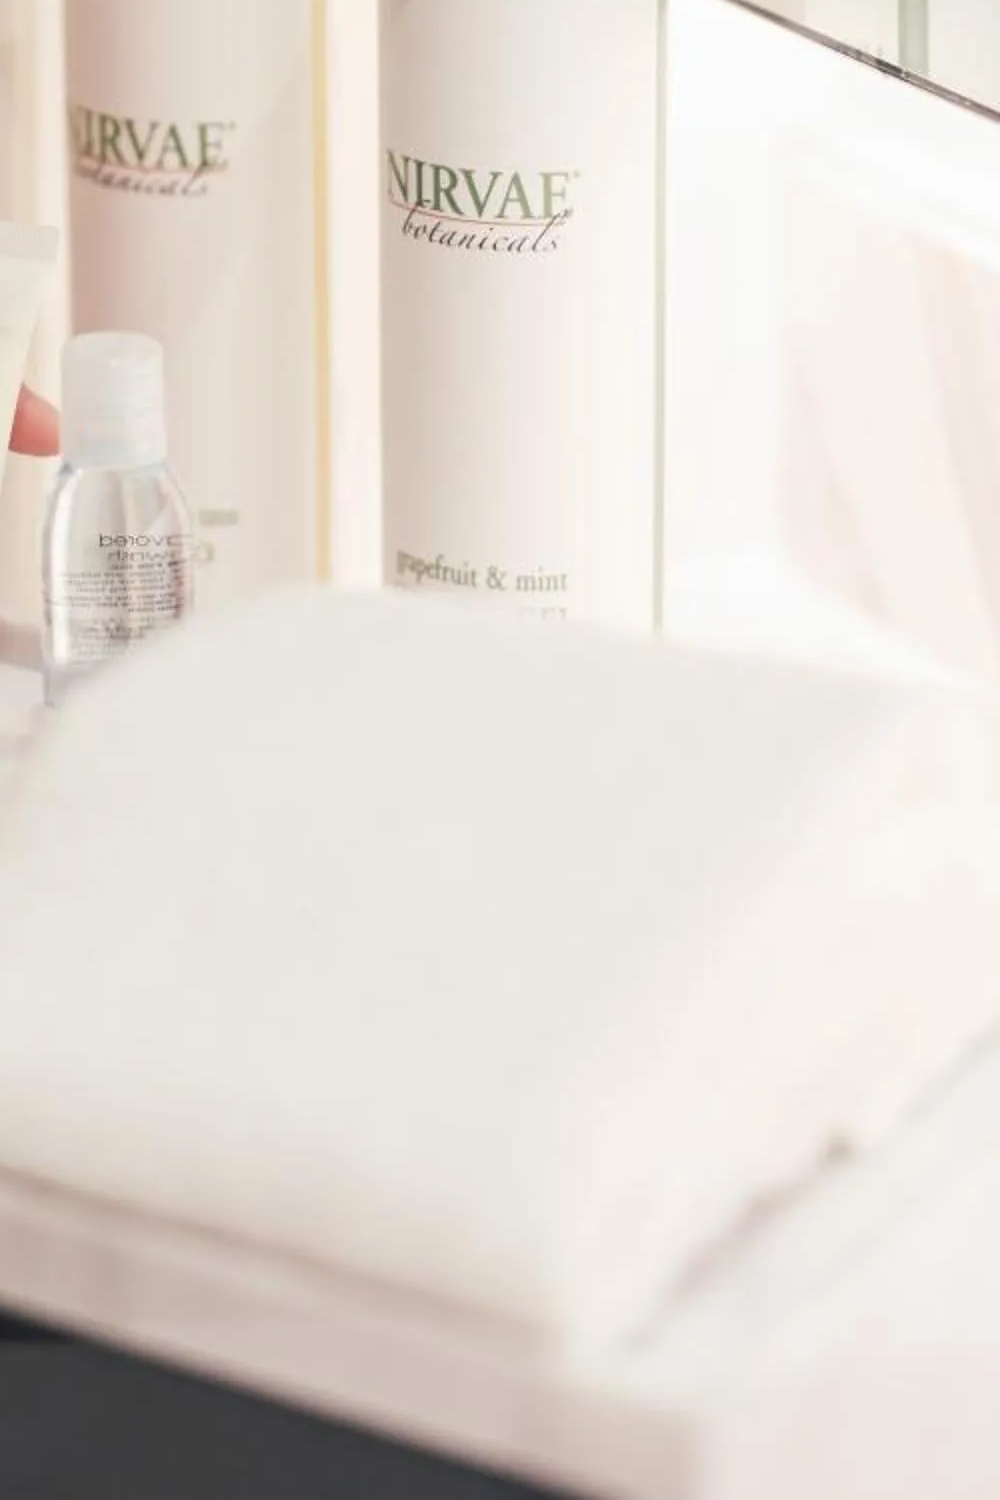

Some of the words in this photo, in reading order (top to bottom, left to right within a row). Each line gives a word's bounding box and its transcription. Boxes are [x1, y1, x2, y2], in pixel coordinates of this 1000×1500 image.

[386, 148, 570, 220] NIRVAE
[401, 200, 573, 253] botanicals
[485, 565, 508, 592] &
[516, 566, 568, 593] mint
